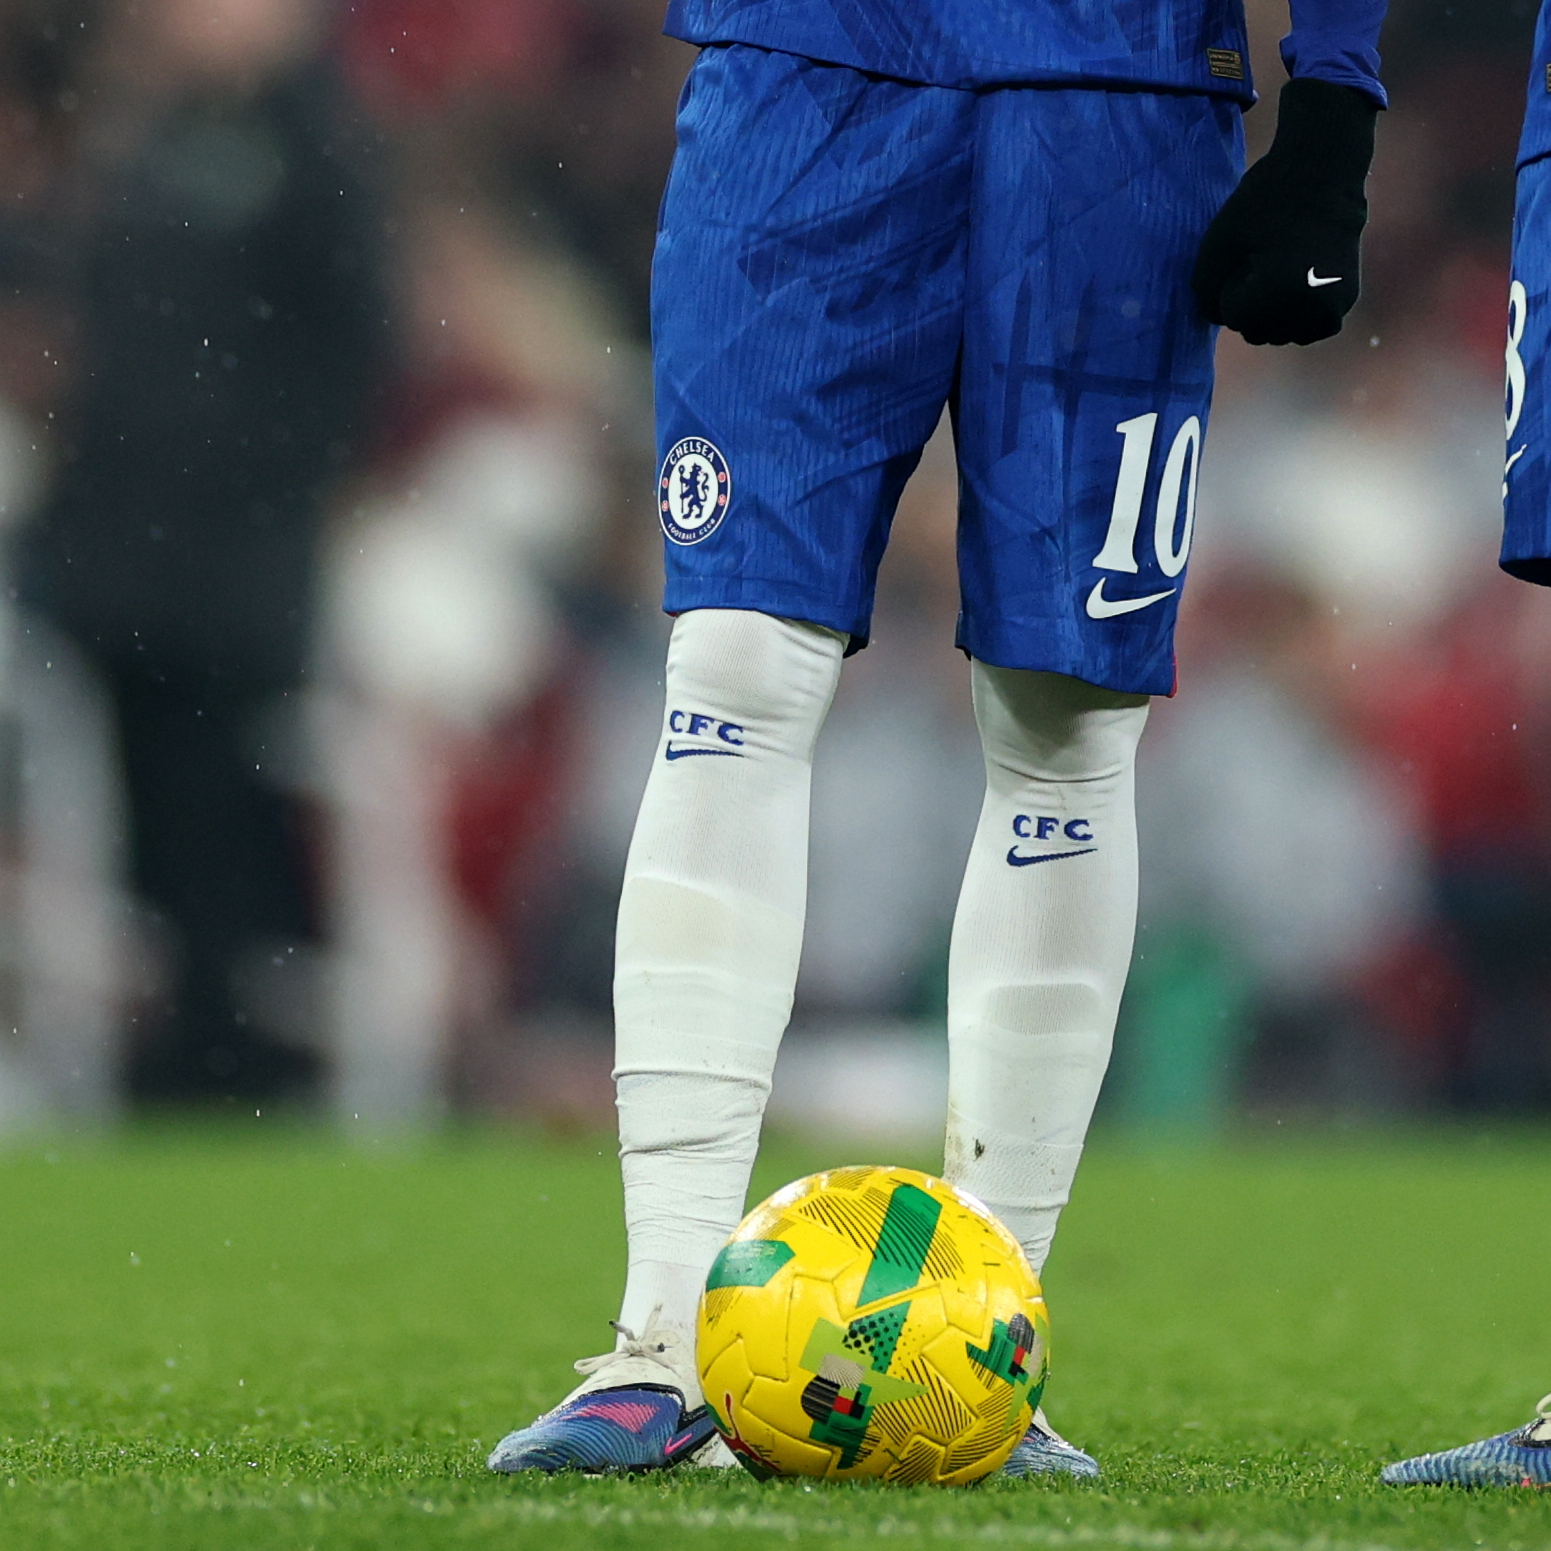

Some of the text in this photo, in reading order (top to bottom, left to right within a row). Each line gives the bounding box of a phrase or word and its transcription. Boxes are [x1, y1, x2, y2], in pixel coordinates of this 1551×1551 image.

[669, 441, 715, 466] CHELSEA
[1092, 412, 1201, 578] 10
[669, 709, 745, 746] CFC
[1012, 814, 1094, 841] CFC
